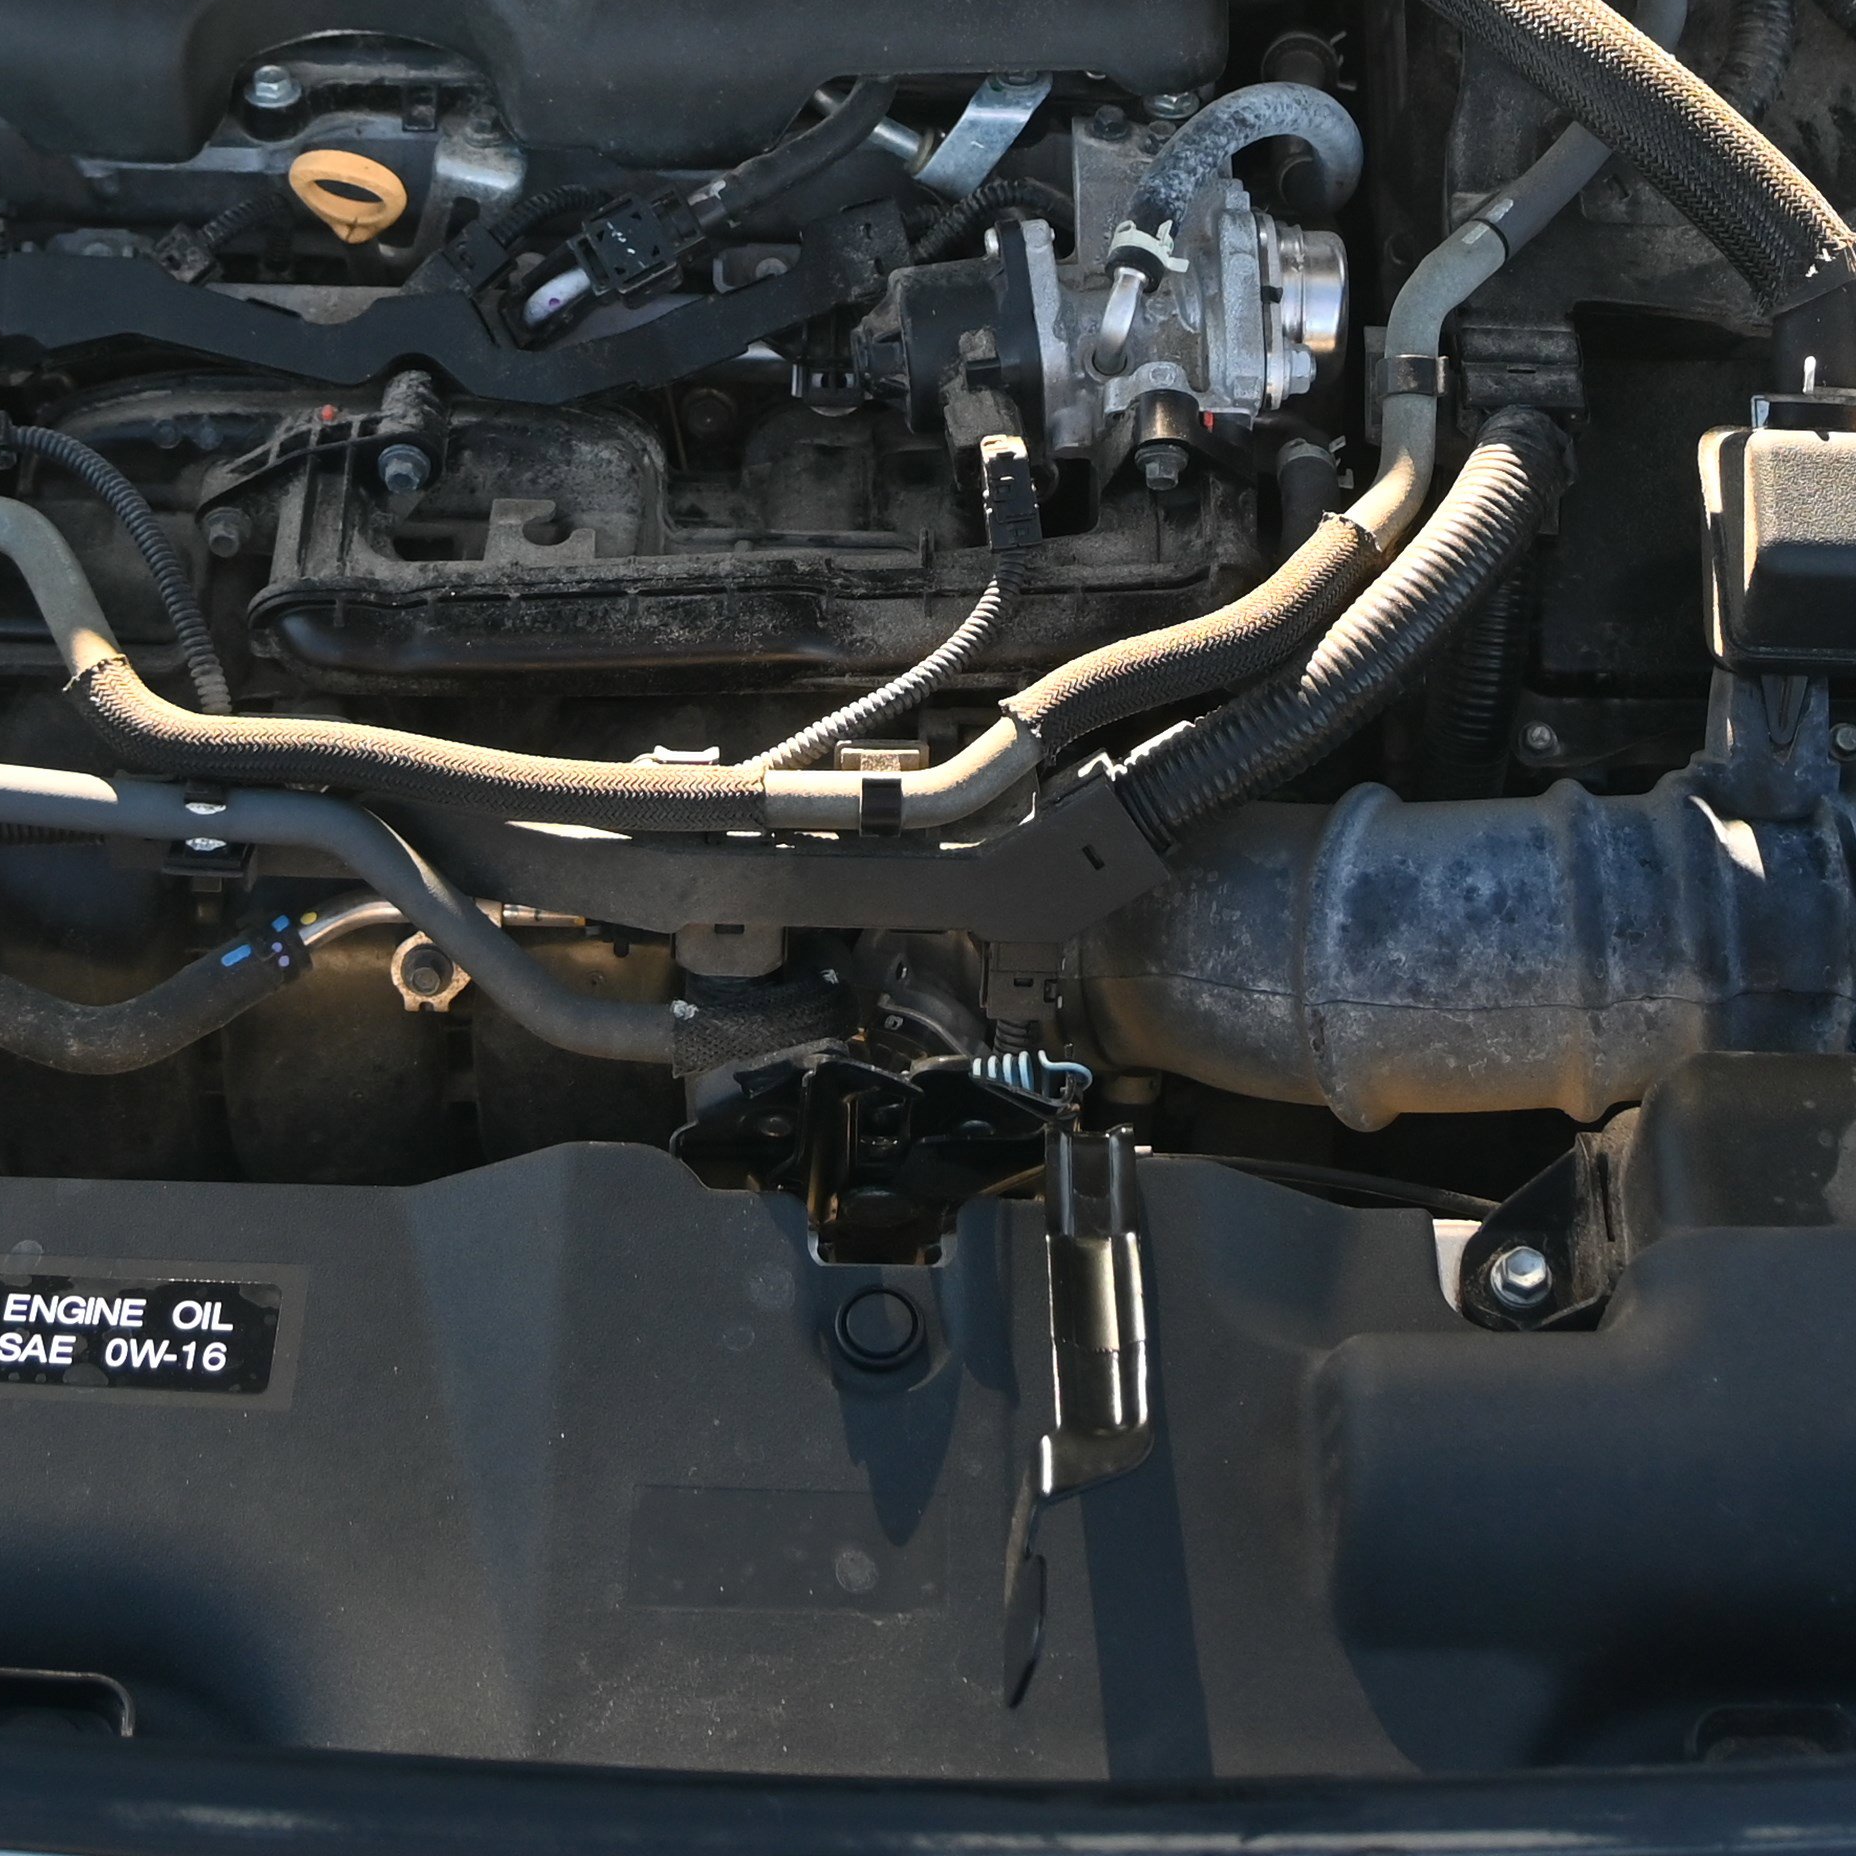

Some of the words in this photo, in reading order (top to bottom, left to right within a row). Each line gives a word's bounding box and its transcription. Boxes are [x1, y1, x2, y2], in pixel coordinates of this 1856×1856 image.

[2, 1293, 147, 1327] ENGINE
[171, 1300, 234, 1332] OIL
[105, 1337, 228, 1372] 0W-16
